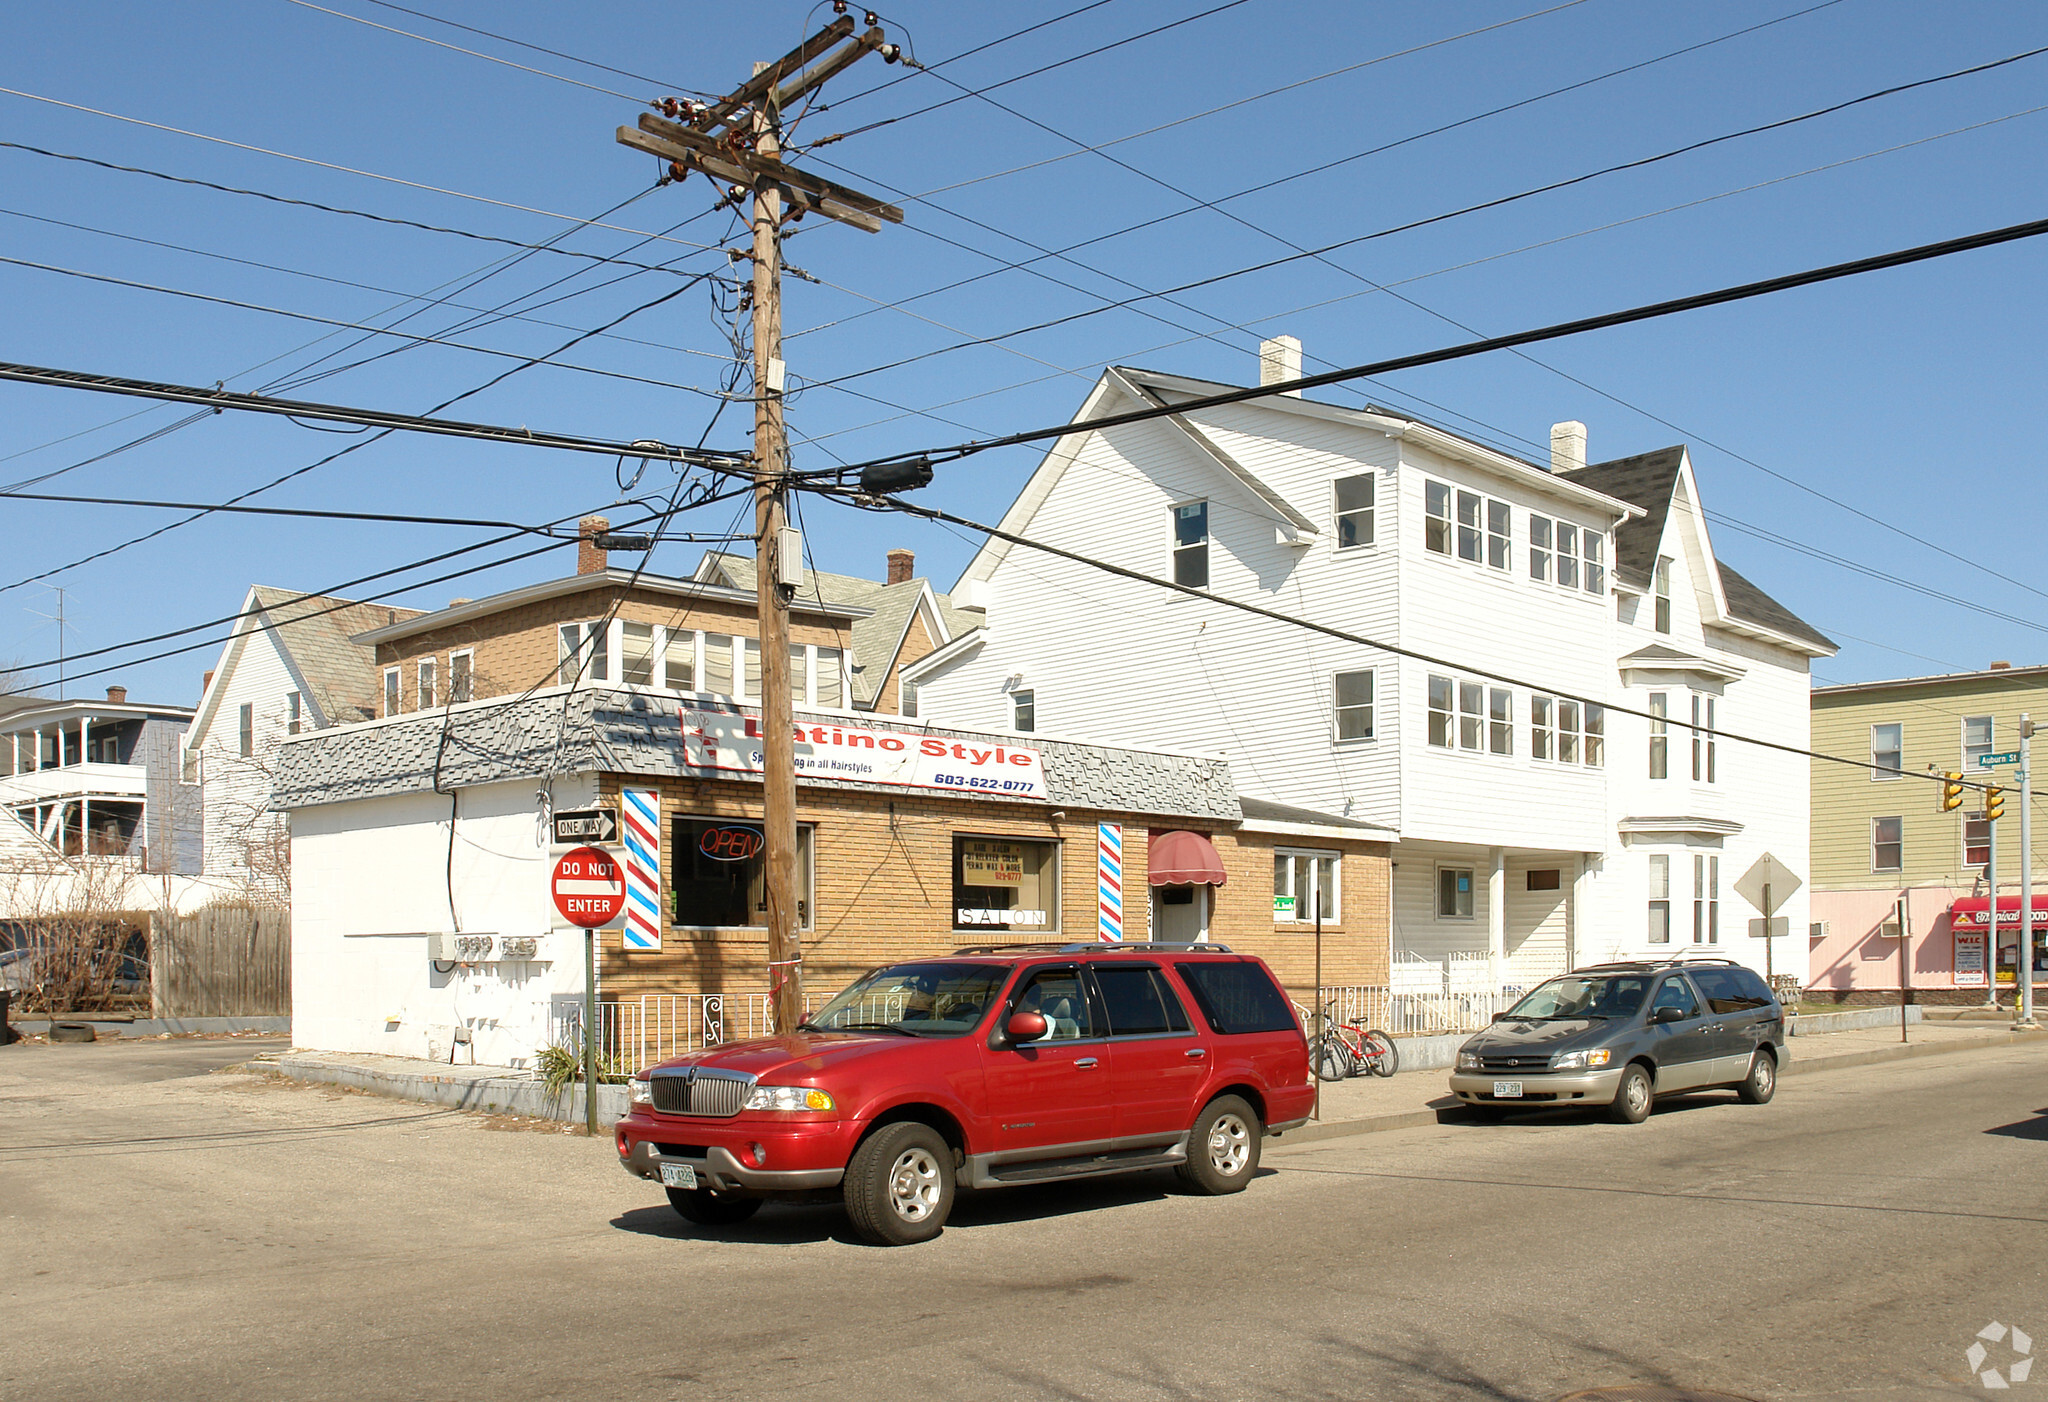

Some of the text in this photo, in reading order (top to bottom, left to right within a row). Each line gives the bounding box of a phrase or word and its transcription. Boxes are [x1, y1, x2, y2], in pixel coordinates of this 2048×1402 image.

[919, 740, 1033, 766] Style
[1981, 754, 2017, 765] Auburn St
[807, 758, 815, 768] in
[818, 760, 829, 770] all
[831, 761, 873, 774] Hairstyles
[934, 774, 1034, 792] 603-622-0777
[560, 820, 602, 834] ONE WAY
[701, 828, 760, 859] OPEN
[562, 862, 615, 876] DO NOT
[567, 899, 611, 912] ENTER
[962, 907, 1043, 925] SALON
